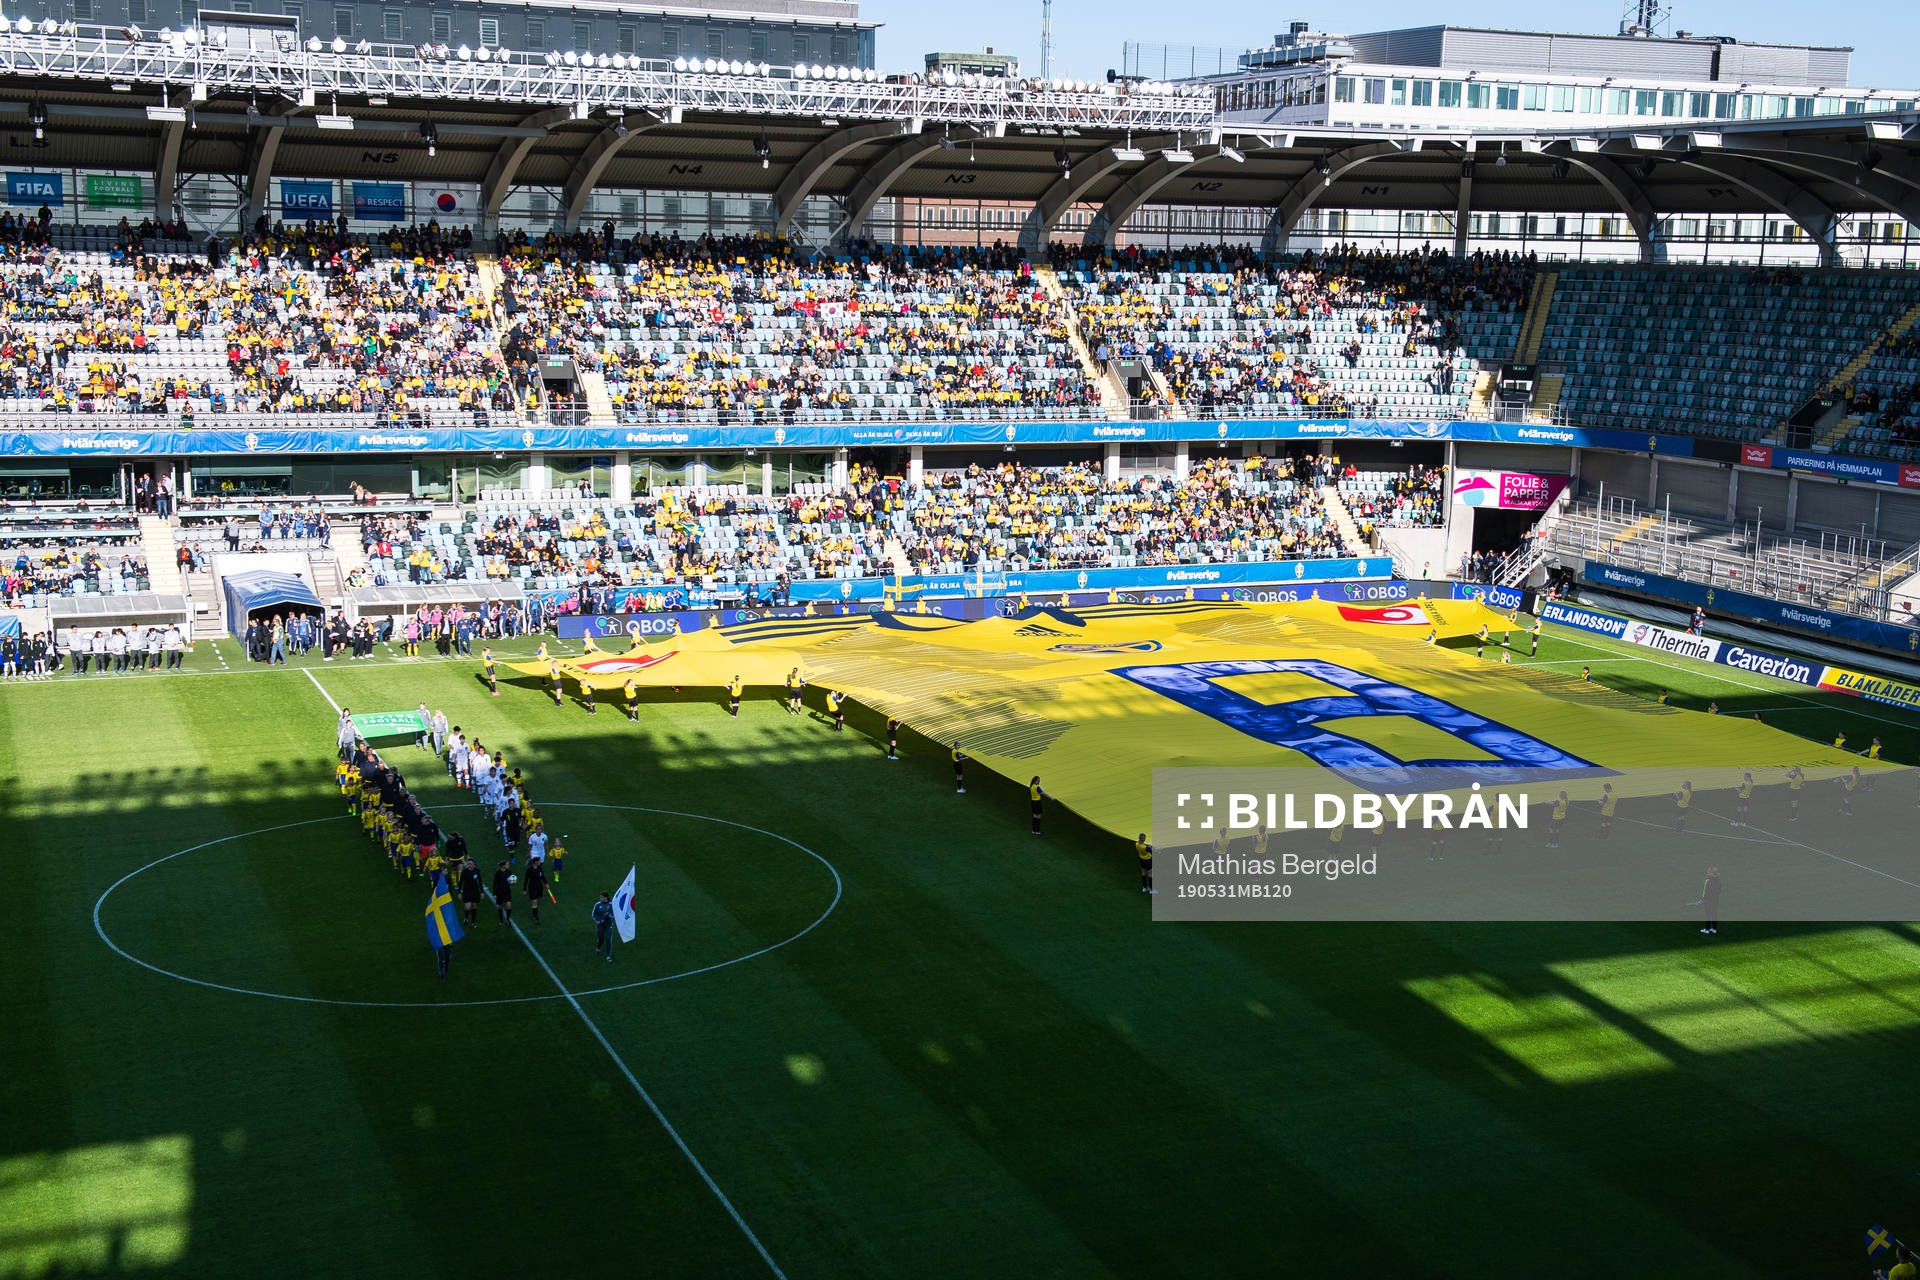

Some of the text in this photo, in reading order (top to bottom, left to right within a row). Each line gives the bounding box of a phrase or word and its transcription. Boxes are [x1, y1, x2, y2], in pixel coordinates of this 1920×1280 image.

[669, 164, 703, 174] N4
[944, 174, 977, 184] N3
[15, 182, 55, 196] FIFA
[1191, 181, 1223, 192] N2
[1361, 186, 1391, 197] N1
[284, 193, 329, 208] UEFA
[367, 198, 403, 207] RESPECT
[358, 434, 428, 447] #viärsverige
[1518, 428, 1574, 441] #viärsverige
[62, 437, 139, 450] #viärsverige
[1787, 456, 1883, 477] PARKERING PÅ HEMMAPLAN
[1504, 476, 1549, 489] FOLIE &
[1503, 487, 1549, 500] PAPPER
[1166, 570, 1220, 582] #viärsverige
[1604, 569, 1645, 587] #viärsverige
[929, 582, 939, 590] ÄR
[940, 582, 960, 590] OLIKA
[1367, 585, 1407, 599] OBOS
[1257, 590, 1298, 602] OBOS
[1489, 588, 1521, 610] OBOS
[1543, 605, 1622, 634] ERLANDSSON
[1781, 607, 1832, 629] #viärsverige
[625, 618, 676, 634] OBOS
[1650, 628, 1710, 660] Thermia
[1726, 646, 1810, 683] Caverion
[1837, 673, 1920, 704] BLÅKLÄDER
